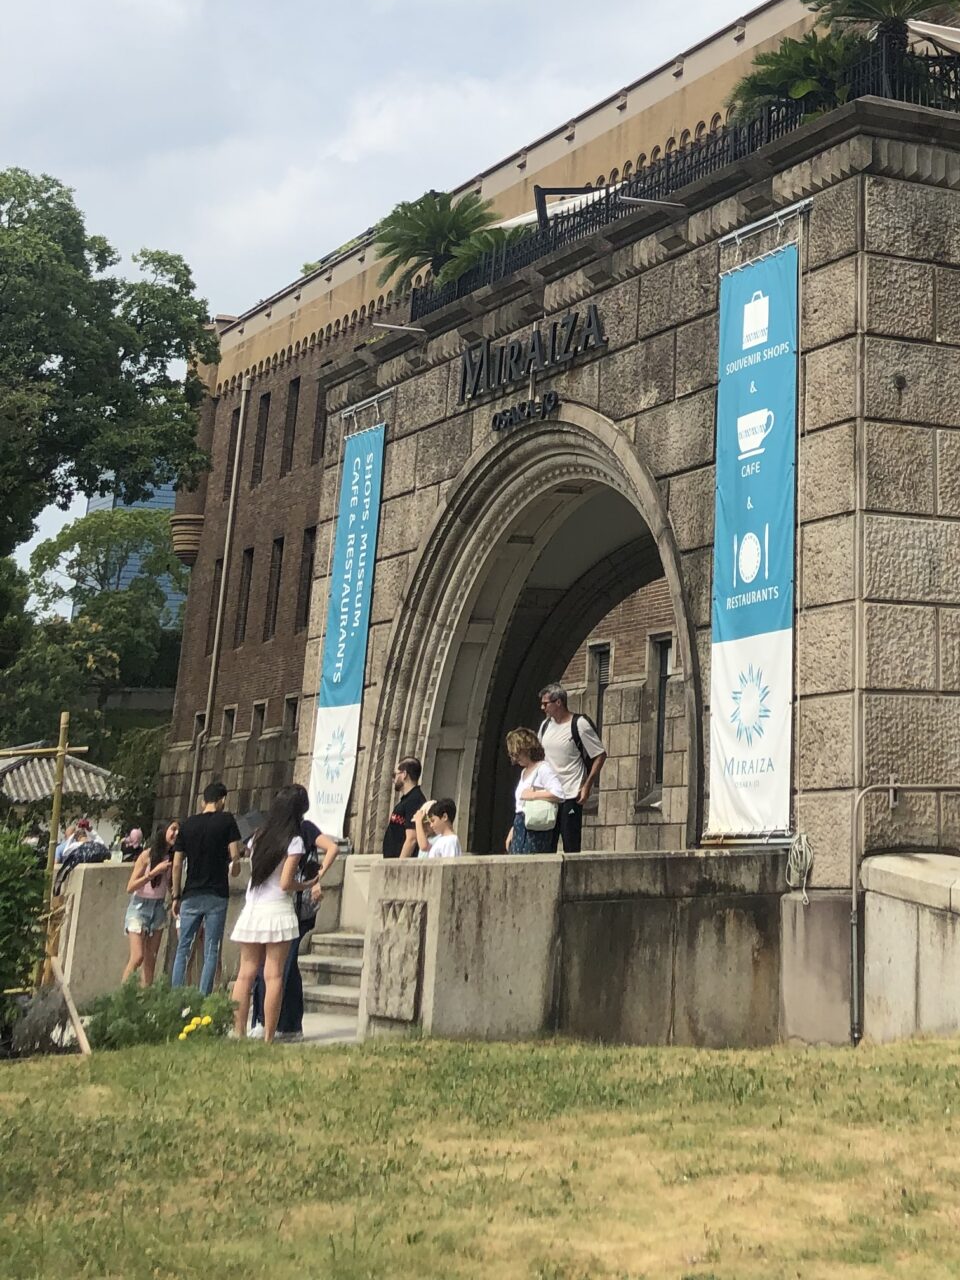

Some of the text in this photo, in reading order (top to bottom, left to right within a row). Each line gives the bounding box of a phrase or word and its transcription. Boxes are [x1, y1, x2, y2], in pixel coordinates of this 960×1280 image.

[457, 304, 609, 406] MIRAIZA
[726, 341, 790, 375] SOUVENIR SHOPS
[750, 380, 758, 394] &
[350, 457, 361, 508] CAFE
[741, 461, 761, 477] CAFE
[362, 452, 374, 521] SHOPS
[746, 495, 754, 510] &
[352, 532, 368, 628] MUSEUM
[332, 533, 355, 684] RESTAURANTS
[726, 585, 779, 610] RESTAURANTS
[723, 757, 775, 776] MIRAIZA
